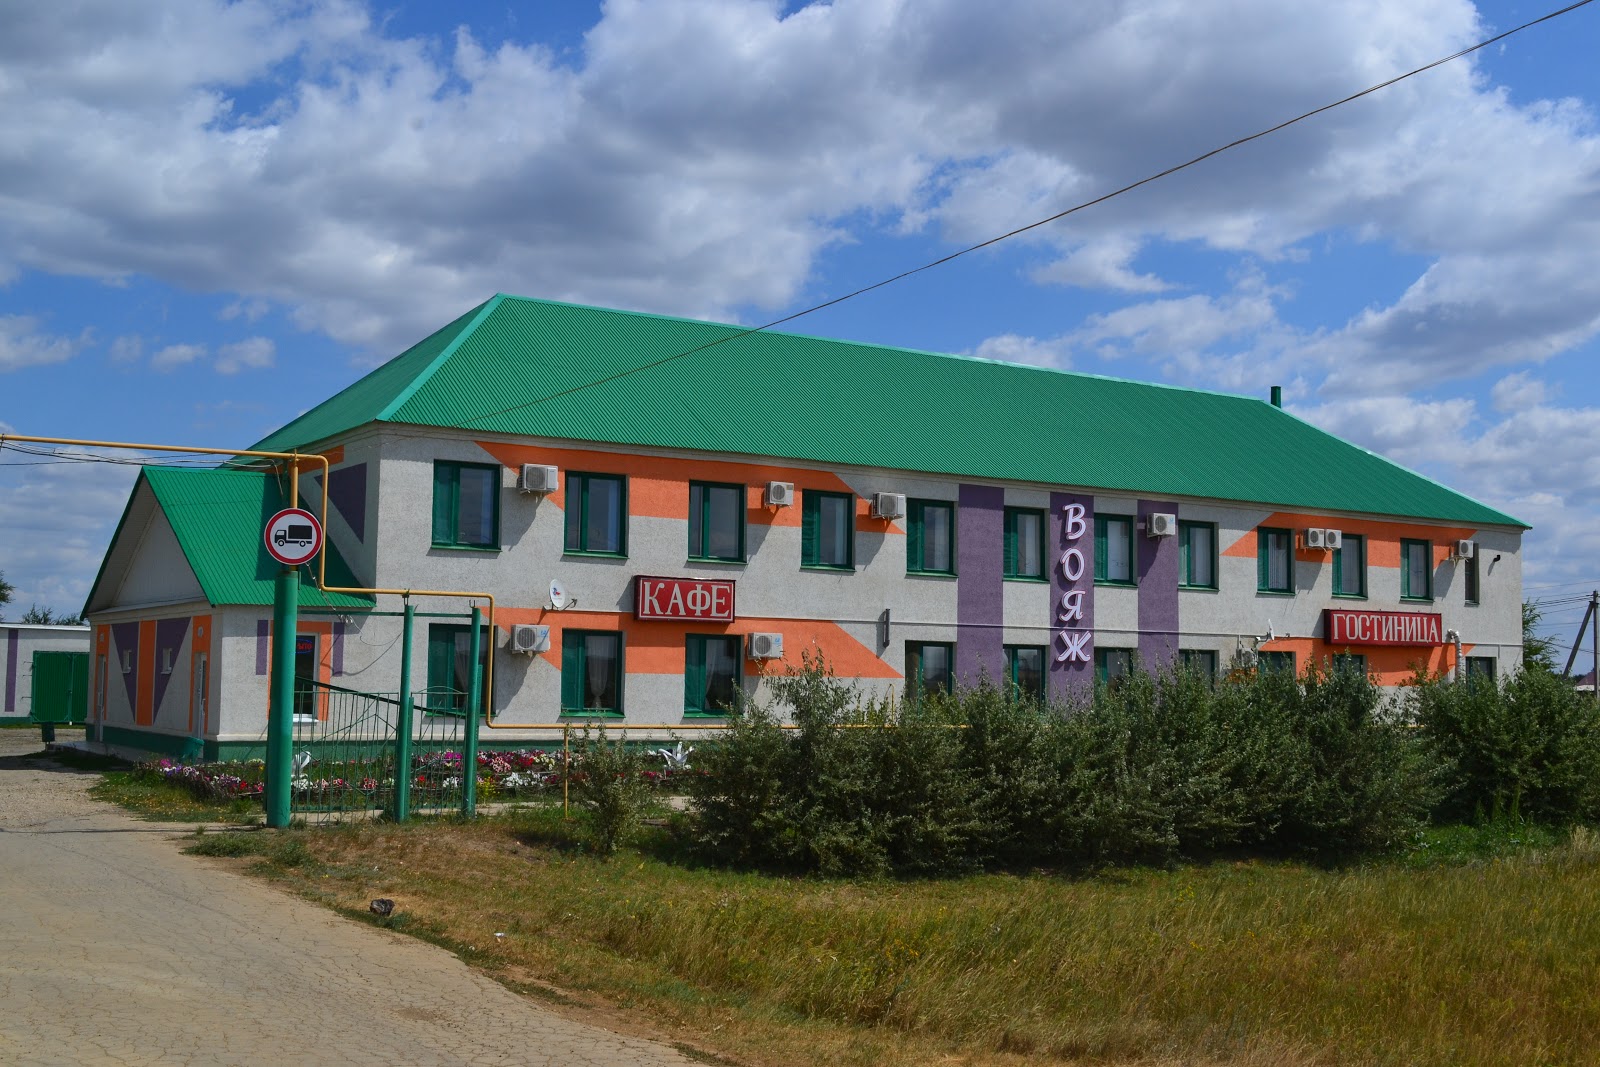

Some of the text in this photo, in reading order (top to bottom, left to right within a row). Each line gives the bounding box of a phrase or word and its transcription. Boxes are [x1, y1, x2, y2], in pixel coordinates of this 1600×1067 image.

[643, 581, 731, 617] КАФЕ
[1056, 503, 1092, 662] ВОЯЖ
[1333, 613, 1440, 643] ГОСТИНИЦА
